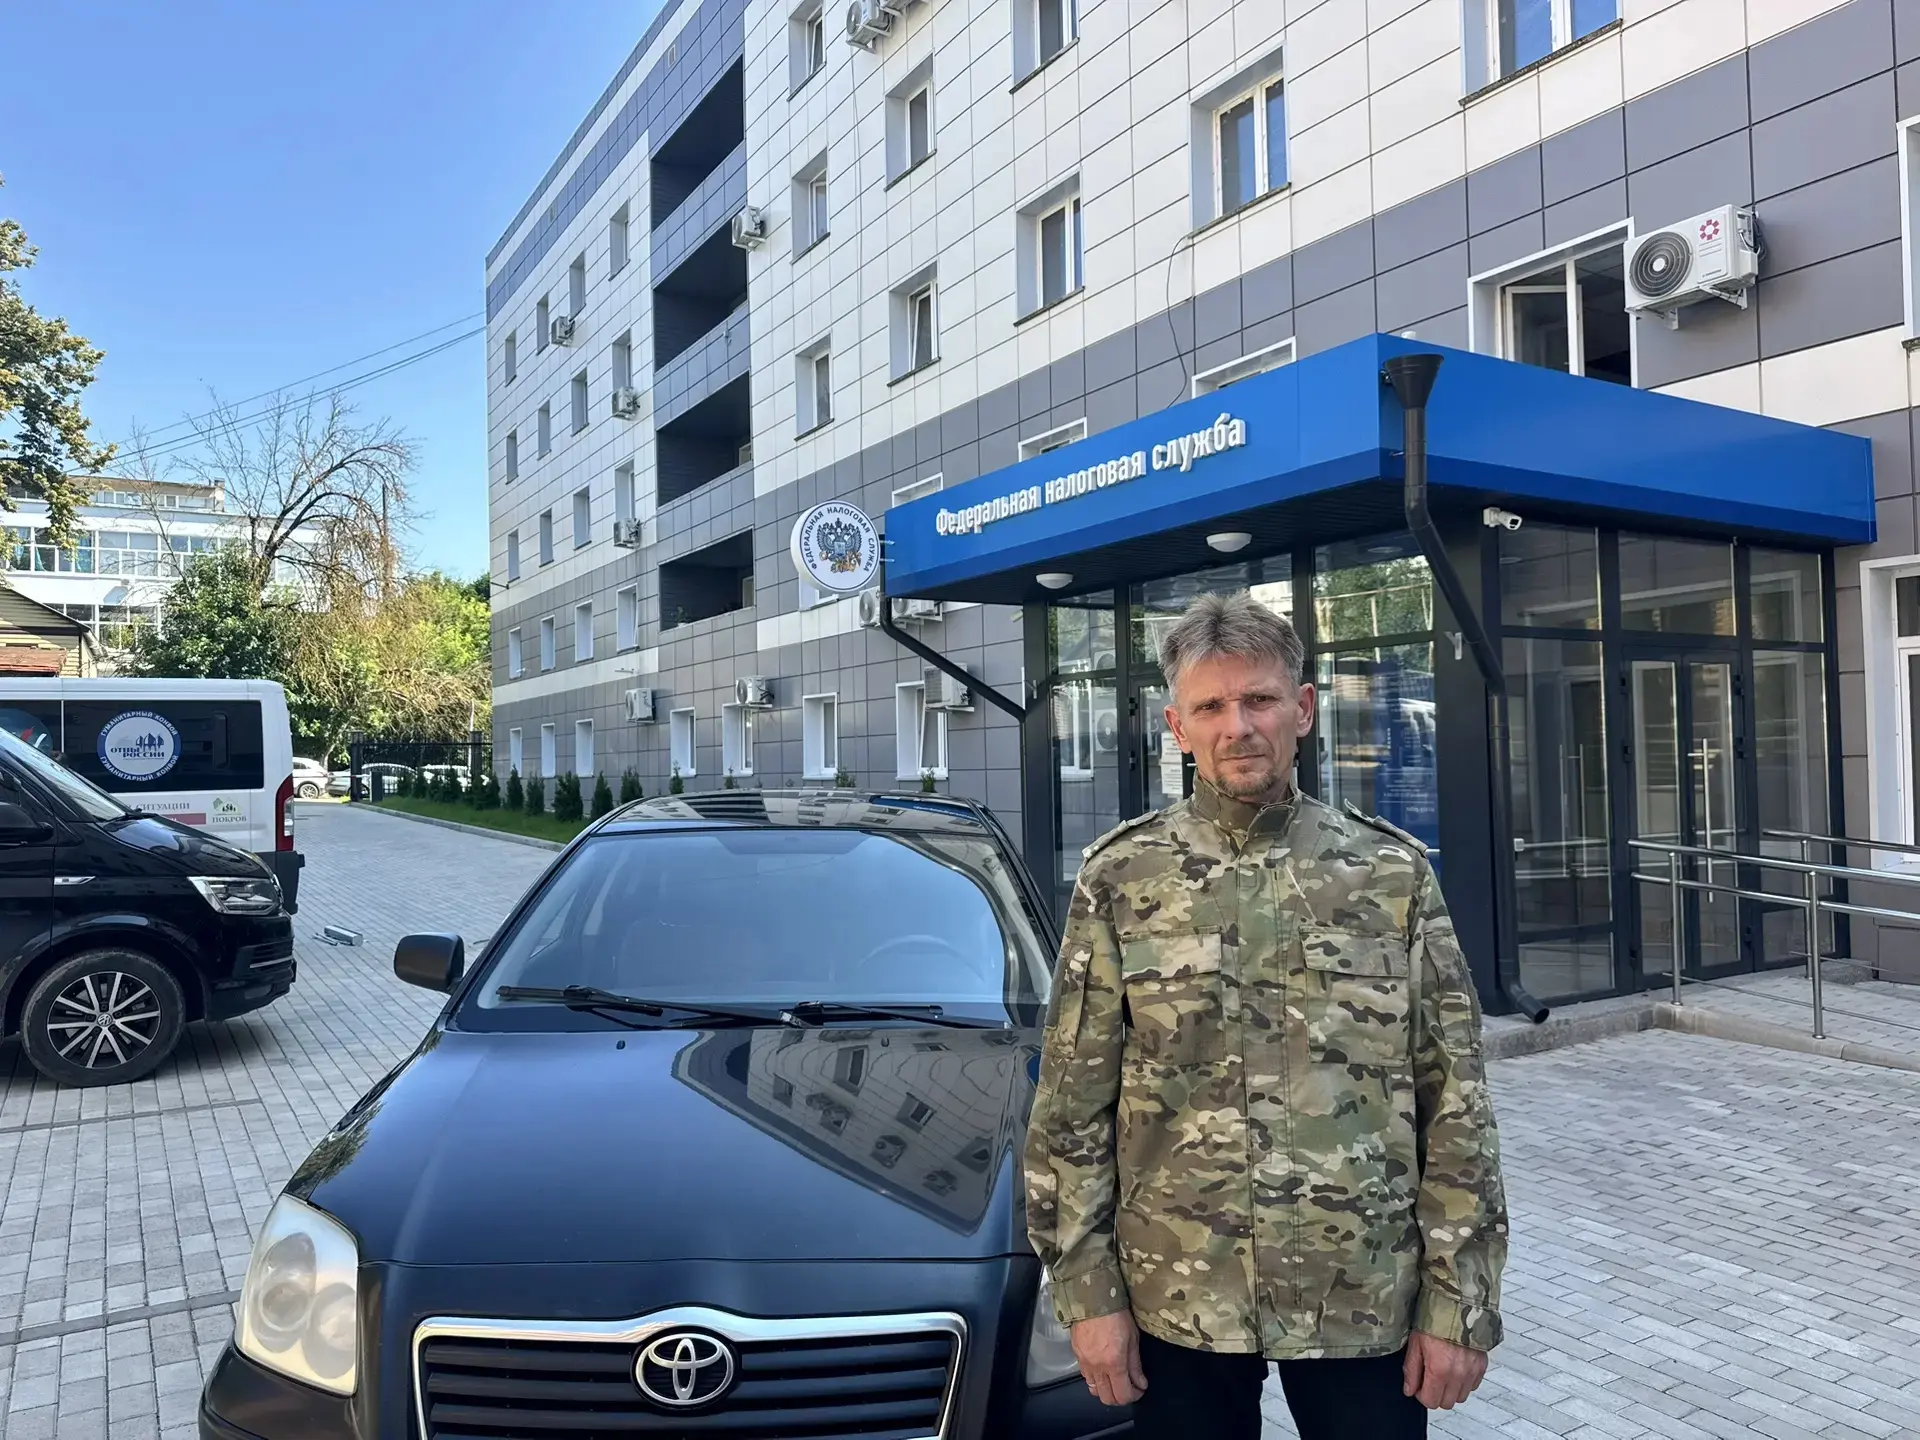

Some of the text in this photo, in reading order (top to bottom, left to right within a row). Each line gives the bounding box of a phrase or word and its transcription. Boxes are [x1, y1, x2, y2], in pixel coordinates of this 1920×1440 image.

[935, 412, 1247, 536] Федеральная налоговая служба
[803, 506, 876, 573] ФЕДЕРАЛЬНАЯ НАЛОГОВАЯ СЛУЖБА
[100, 710, 178, 737] ГУМАНИТАРНЫЙ КОНВОЙ
[100, 754, 179, 782] ГУМАНИТАРНЫЙ КОНВОЙ
[212, 815, 247, 823] ПОКРОВ
